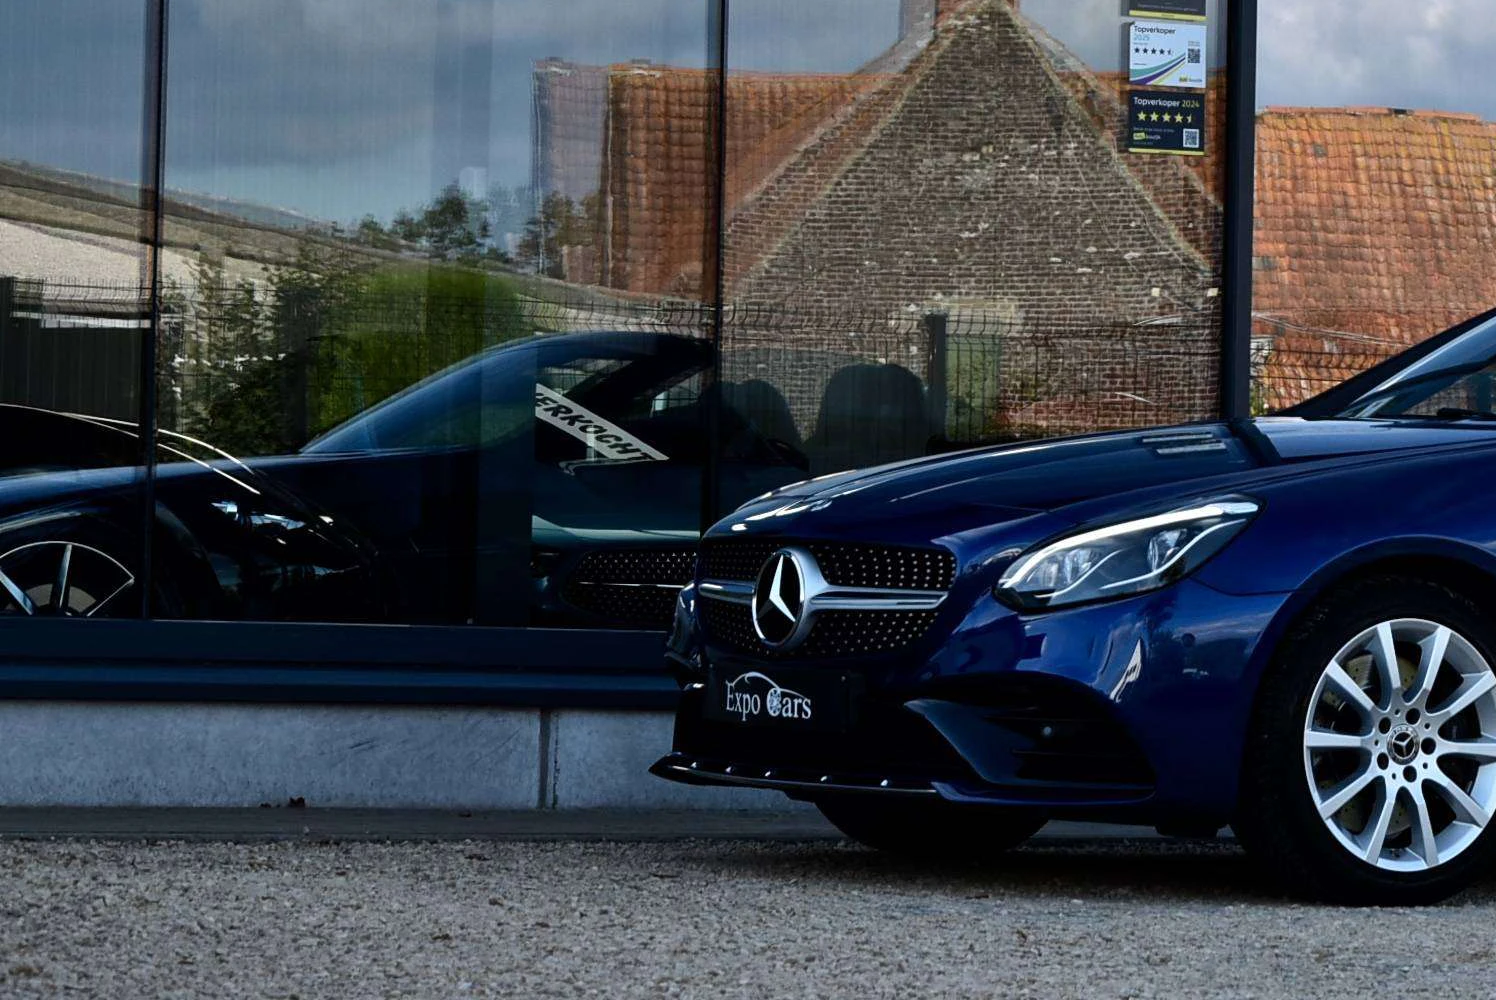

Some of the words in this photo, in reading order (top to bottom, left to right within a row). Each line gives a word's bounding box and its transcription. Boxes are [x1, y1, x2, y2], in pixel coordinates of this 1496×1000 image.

[1133, 25, 1176, 35] Topverkoper
[1133, 96, 1181, 108] Topverkoper
[1181, 99, 1200, 108] 2024
[535, 392, 657, 460] ERKOCHT
[725, 680, 760, 721] Expo
[766, 687, 812, 719] Cars
